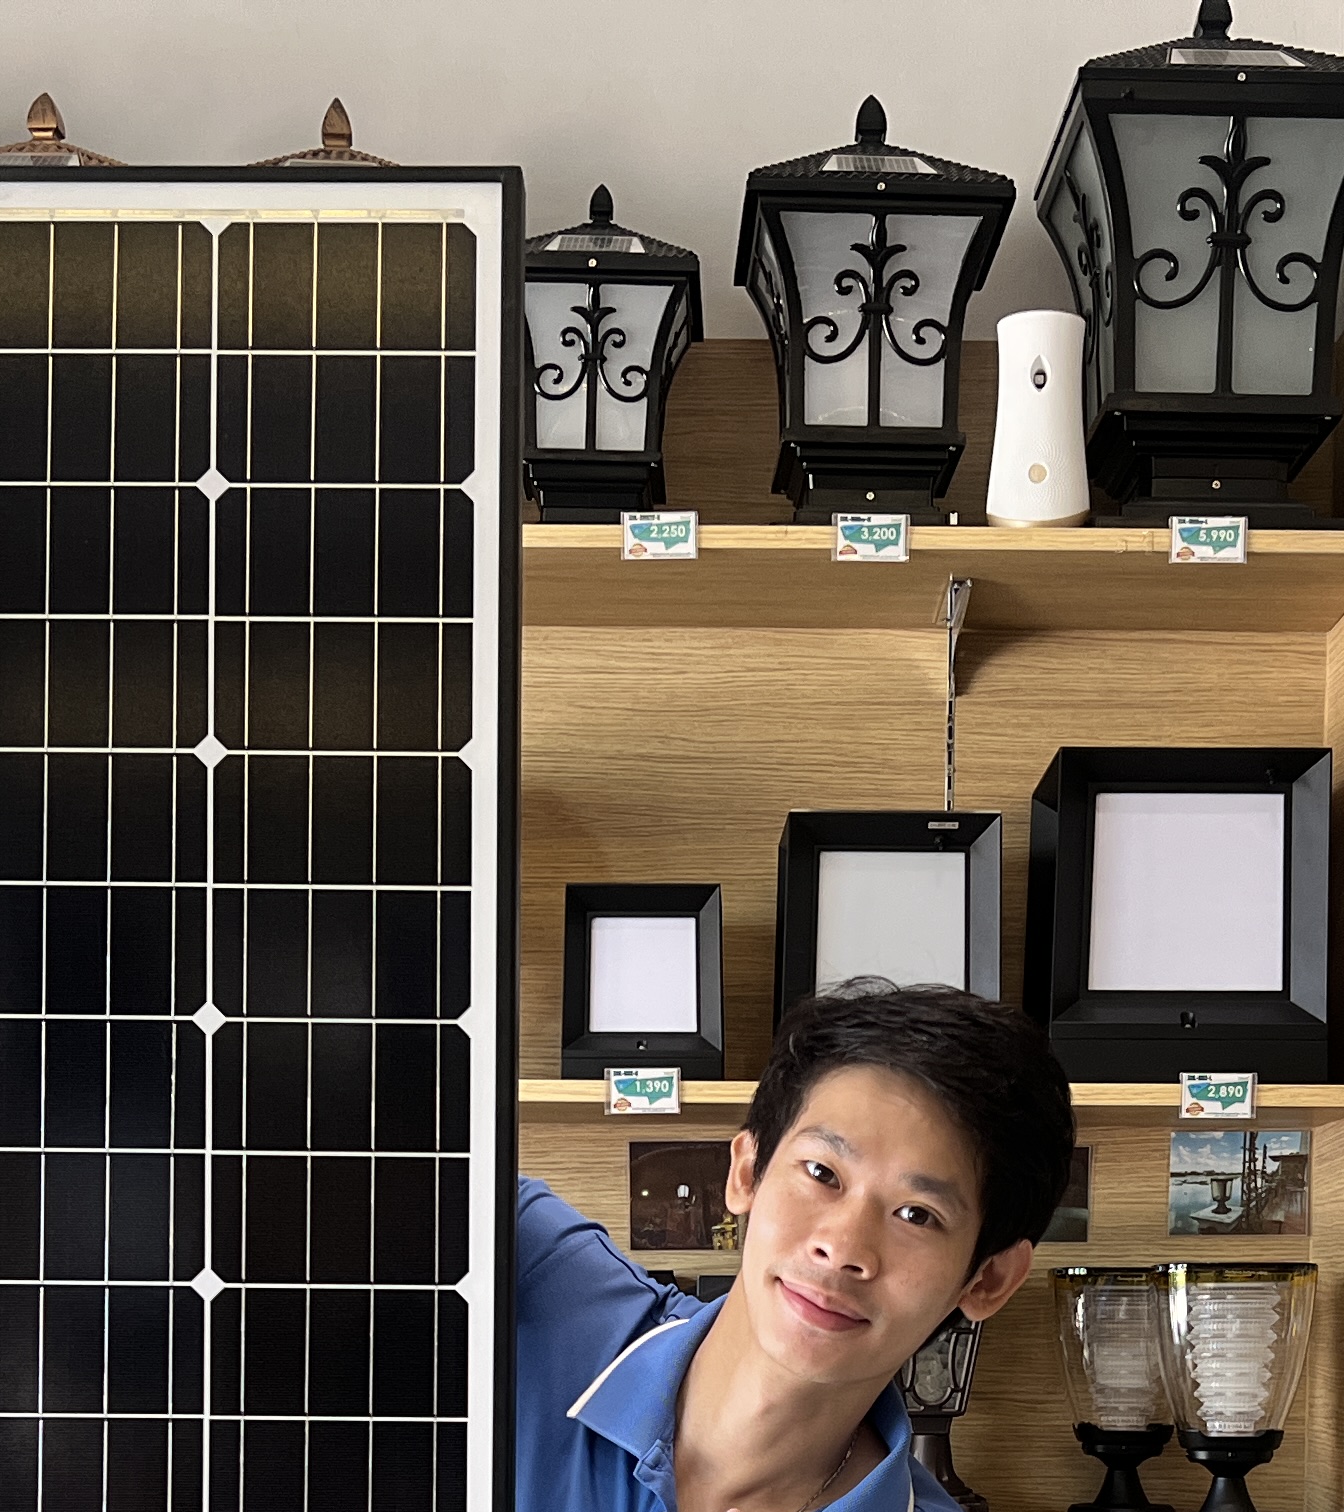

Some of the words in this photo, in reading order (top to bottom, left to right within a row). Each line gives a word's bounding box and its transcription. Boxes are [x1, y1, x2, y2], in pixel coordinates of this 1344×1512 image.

[650, 525, 686, 539] 2,250
[860, 527, 896, 541] 3,200
[1199, 530, 1235, 543] 5,990
[635, 1080, 669, 1094] 1,390
[1207, 1086, 1244, 1100] 2,890
